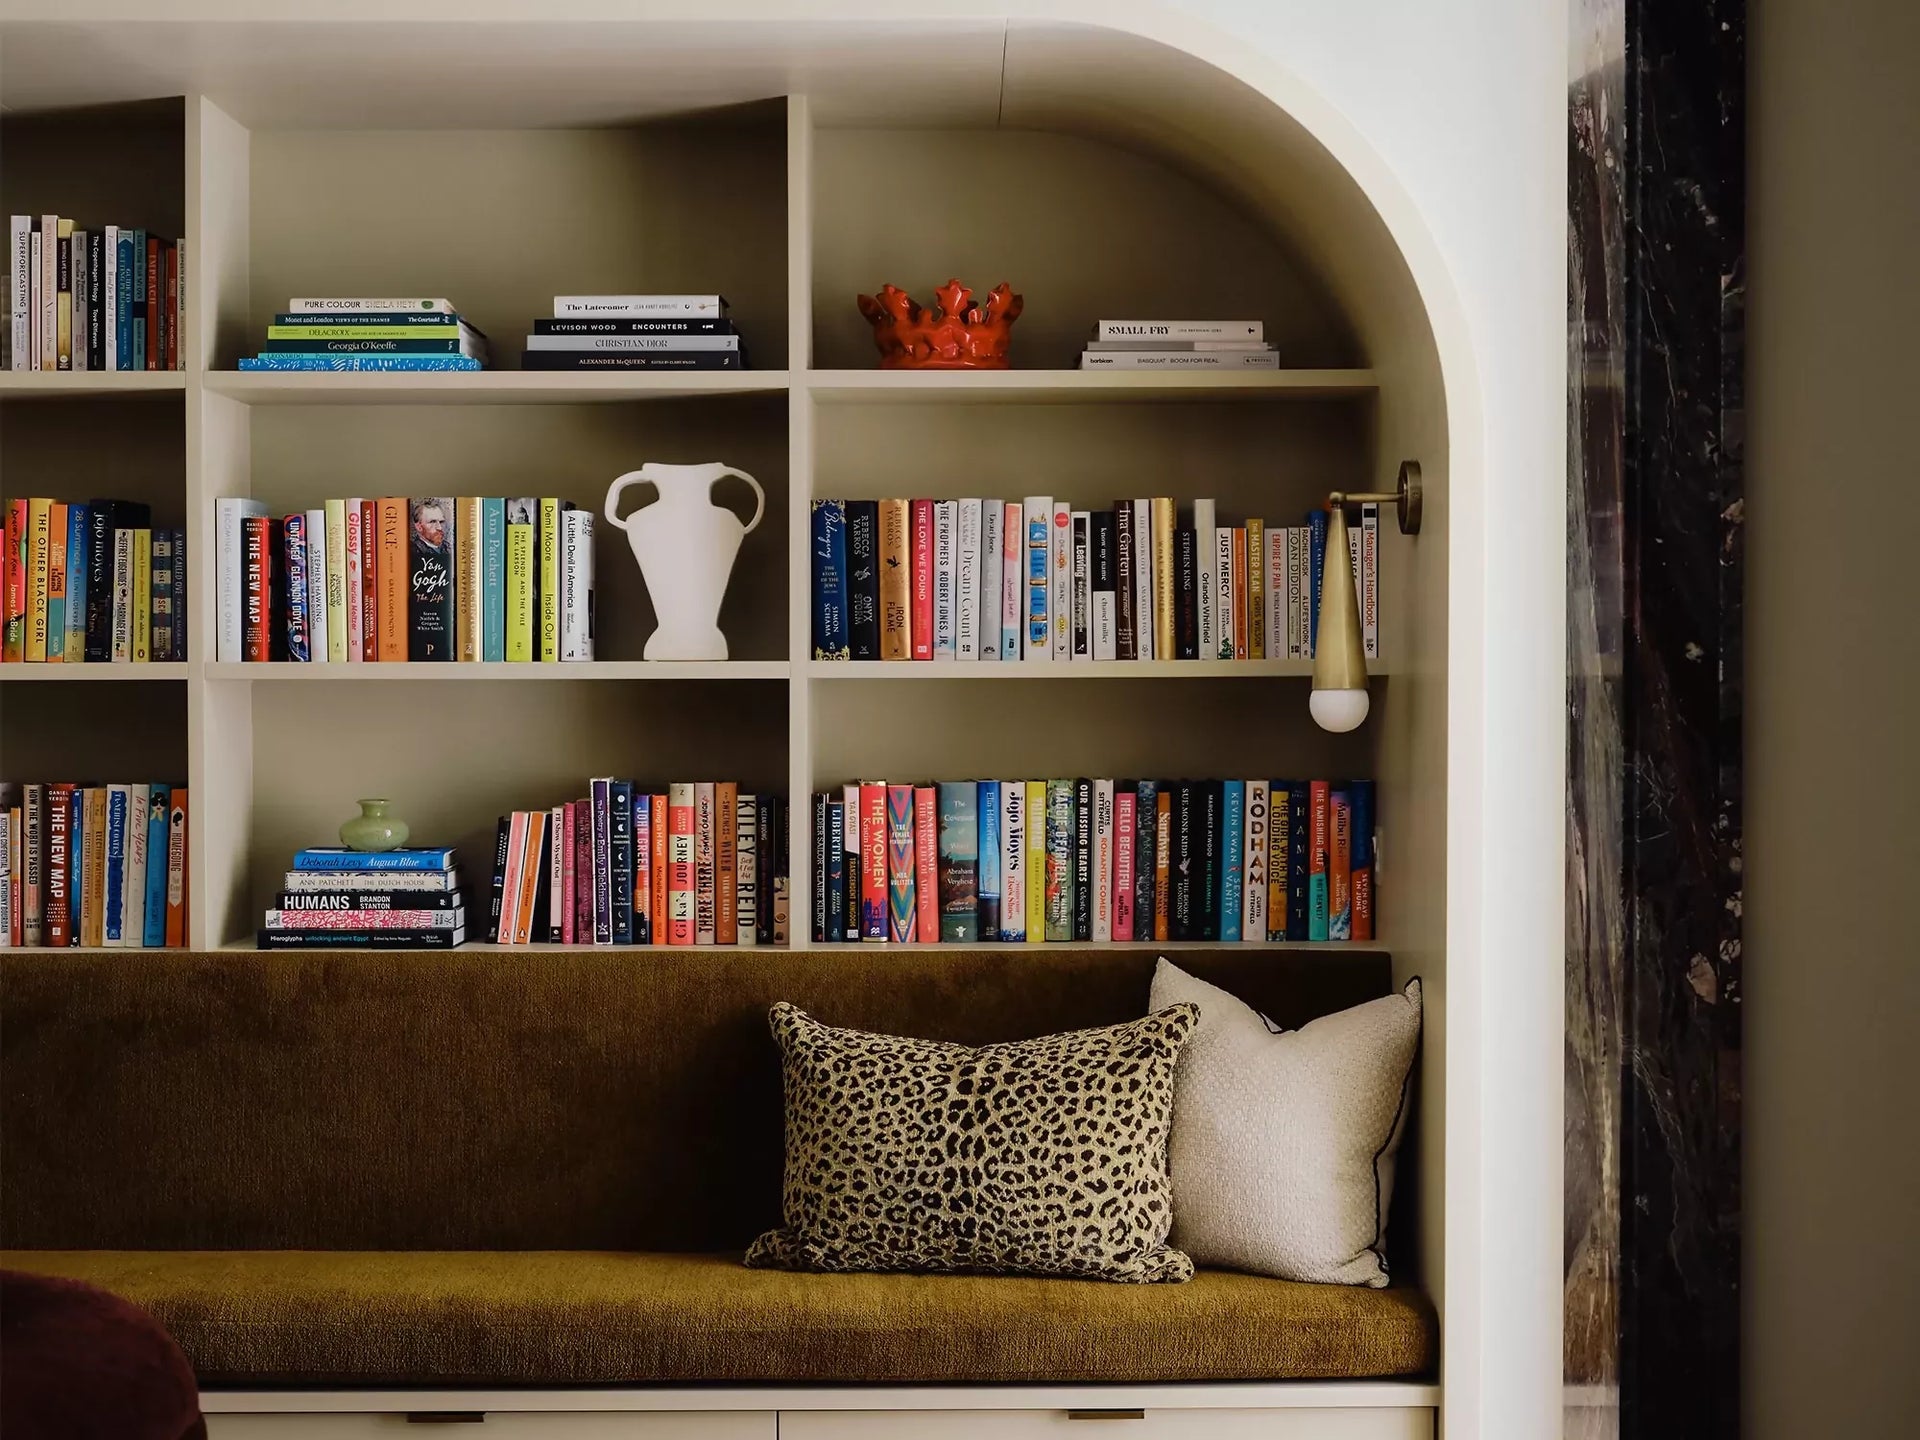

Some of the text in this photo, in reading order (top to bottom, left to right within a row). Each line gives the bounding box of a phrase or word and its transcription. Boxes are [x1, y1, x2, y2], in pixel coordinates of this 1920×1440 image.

[308, 328, 350, 336] DELACROIX
[328, 342, 360, 351] Georgia
[595, 339, 644, 347] CHRISTIAN
[1109, 326, 1170, 335] SMALL FRY
[347, 513, 359, 555] Glossy
[385, 506, 398, 550] GRACE
[853, 519, 861, 555] YARROS
[861, 516, 869, 558] REBECCA
[1120, 509, 1131, 576] Ina Garten
[1289, 531, 1298, 560] JOAN
[38, 538, 46, 571] OTHER
[249, 536, 260, 560] THE
[489, 507, 499, 586] Ann Patchett
[567, 545, 575, 565] Devil
[919, 553, 926, 567] WE
[939, 506, 949, 602] THE PROPHETS ROBERT
[1074, 545, 1086, 577] Leaving
[1099, 549, 1106, 559] my
[1251, 534, 1260, 592] MASTER PLAN
[1272, 534, 1281, 589] EMPIRE OF PAIN
[249, 564, 260, 590] NEW
[290, 522, 302, 630] UNTAMED DOYLE
[545, 506, 554, 640] Demi Moore Inside Out
[567, 566, 575, 574] in
[961, 550, 975, 594] Dream
[1220, 534, 1229, 598] JUST MERCY
[1290, 564, 1299, 603] DIDION
[37, 578, 45, 612] BLACK
[249, 596, 260, 623] MAP
[567, 576, 575, 608] America
[1202, 573, 1210, 644] Orlando Whitfield
[1366, 580, 1375, 626] Handbook
[36, 619, 44, 643] GIRL
[887, 601, 895, 633] FLAME
[896, 606, 904, 628] IRON
[29, 789, 38, 804] HOW
[1056, 788, 1068, 825] MAGGIE
[1079, 785, 1088, 803] OUR
[29, 807, 38, 822] THE
[52, 806, 65, 833] THE
[863, 817, 871, 842] Kristin
[1006, 792, 1023, 870] Jojo Moyes
[1079, 807, 1088, 845] MISSING
[1230, 792, 1239, 862] KEVIN KWAN
[1316, 789, 1325, 866] THE VANISHING HALF
[29, 825, 38, 845] WORD
[51, 836, 65, 864] NEW
[171, 833, 182, 871] HOMEGOING
[831, 809, 841, 862] LIBERTIE
[872, 797, 884, 887] THE WOMEN
[1119, 800, 1130, 892] HELLO BEAUTIFUL
[1157, 812, 1170, 869] Sandwich
[1270, 806, 1280, 884] LOUDING VOICE
[1279, 799, 1288, 893] THE GIRL WITH THE
[29, 857, 38, 884] PASSED
[367, 858, 419, 868] August Blue
[596, 811, 606, 912] Poetry Emily Dickinson
[676, 836, 688, 884] JOURNEY
[737, 800, 755, 927] KILEY REID
[1079, 849, 1087, 882] HEARTS
[51, 869, 64, 897] MAP
[698, 862, 712, 933] THERE THERE
[1099, 837, 1108, 922] ROMANTIC COMEDY
[1225, 875, 1233, 915] VANITY
[284, 895, 350, 910] HUMANS
[1078, 913, 1086, 922] Ng
